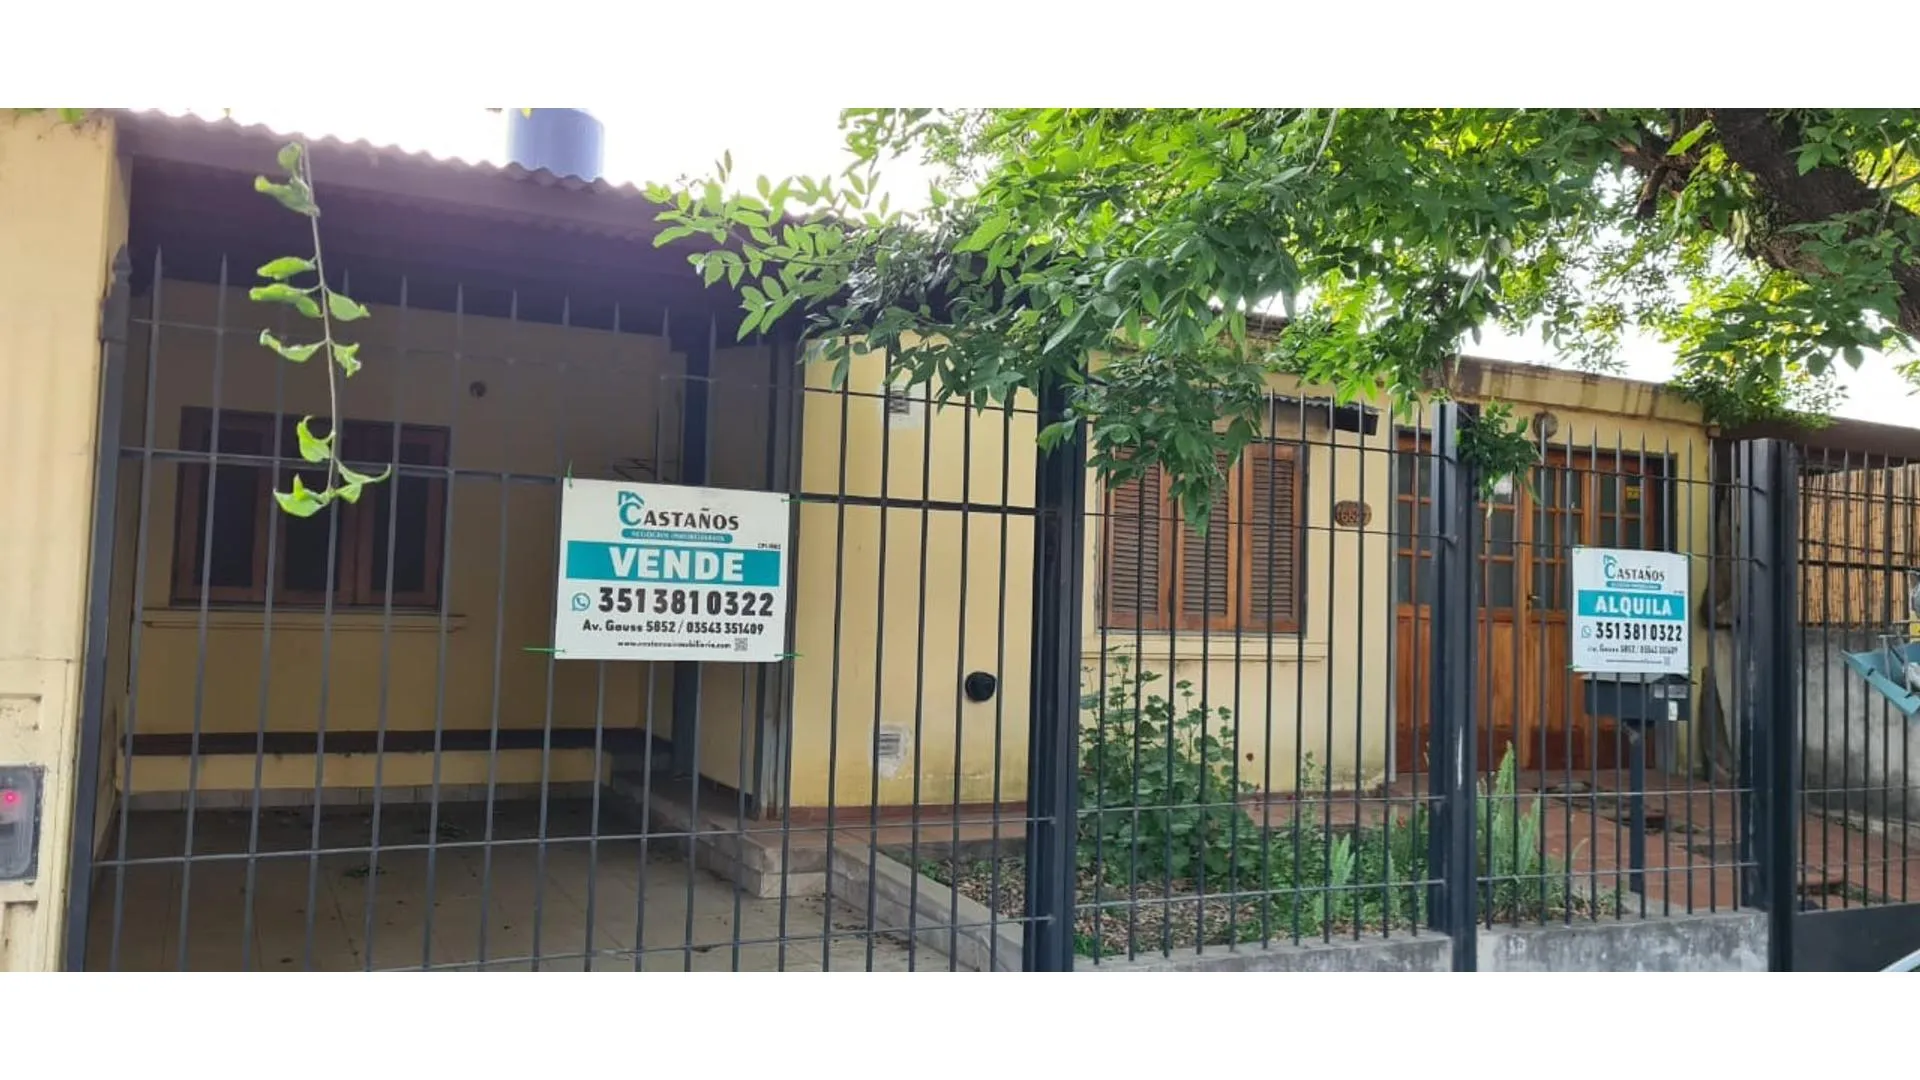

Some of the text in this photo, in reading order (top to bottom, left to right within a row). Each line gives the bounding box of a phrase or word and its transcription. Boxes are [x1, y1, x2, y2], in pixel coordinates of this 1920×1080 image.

[618, 501, 740, 531] CASTAÑOS
[608, 546, 745, 582] VENDE
[1604, 562, 1665, 582] CASTAÑOS
[1595, 595, 1673, 617] ALQUILA
[582, 618, 602, 632] Av.
[605, 619, 643, 633] Gauss
[646, 620, 676, 633] 5852
[686, 621, 722, 635] 03543
[724, 622, 764, 635] 351409
